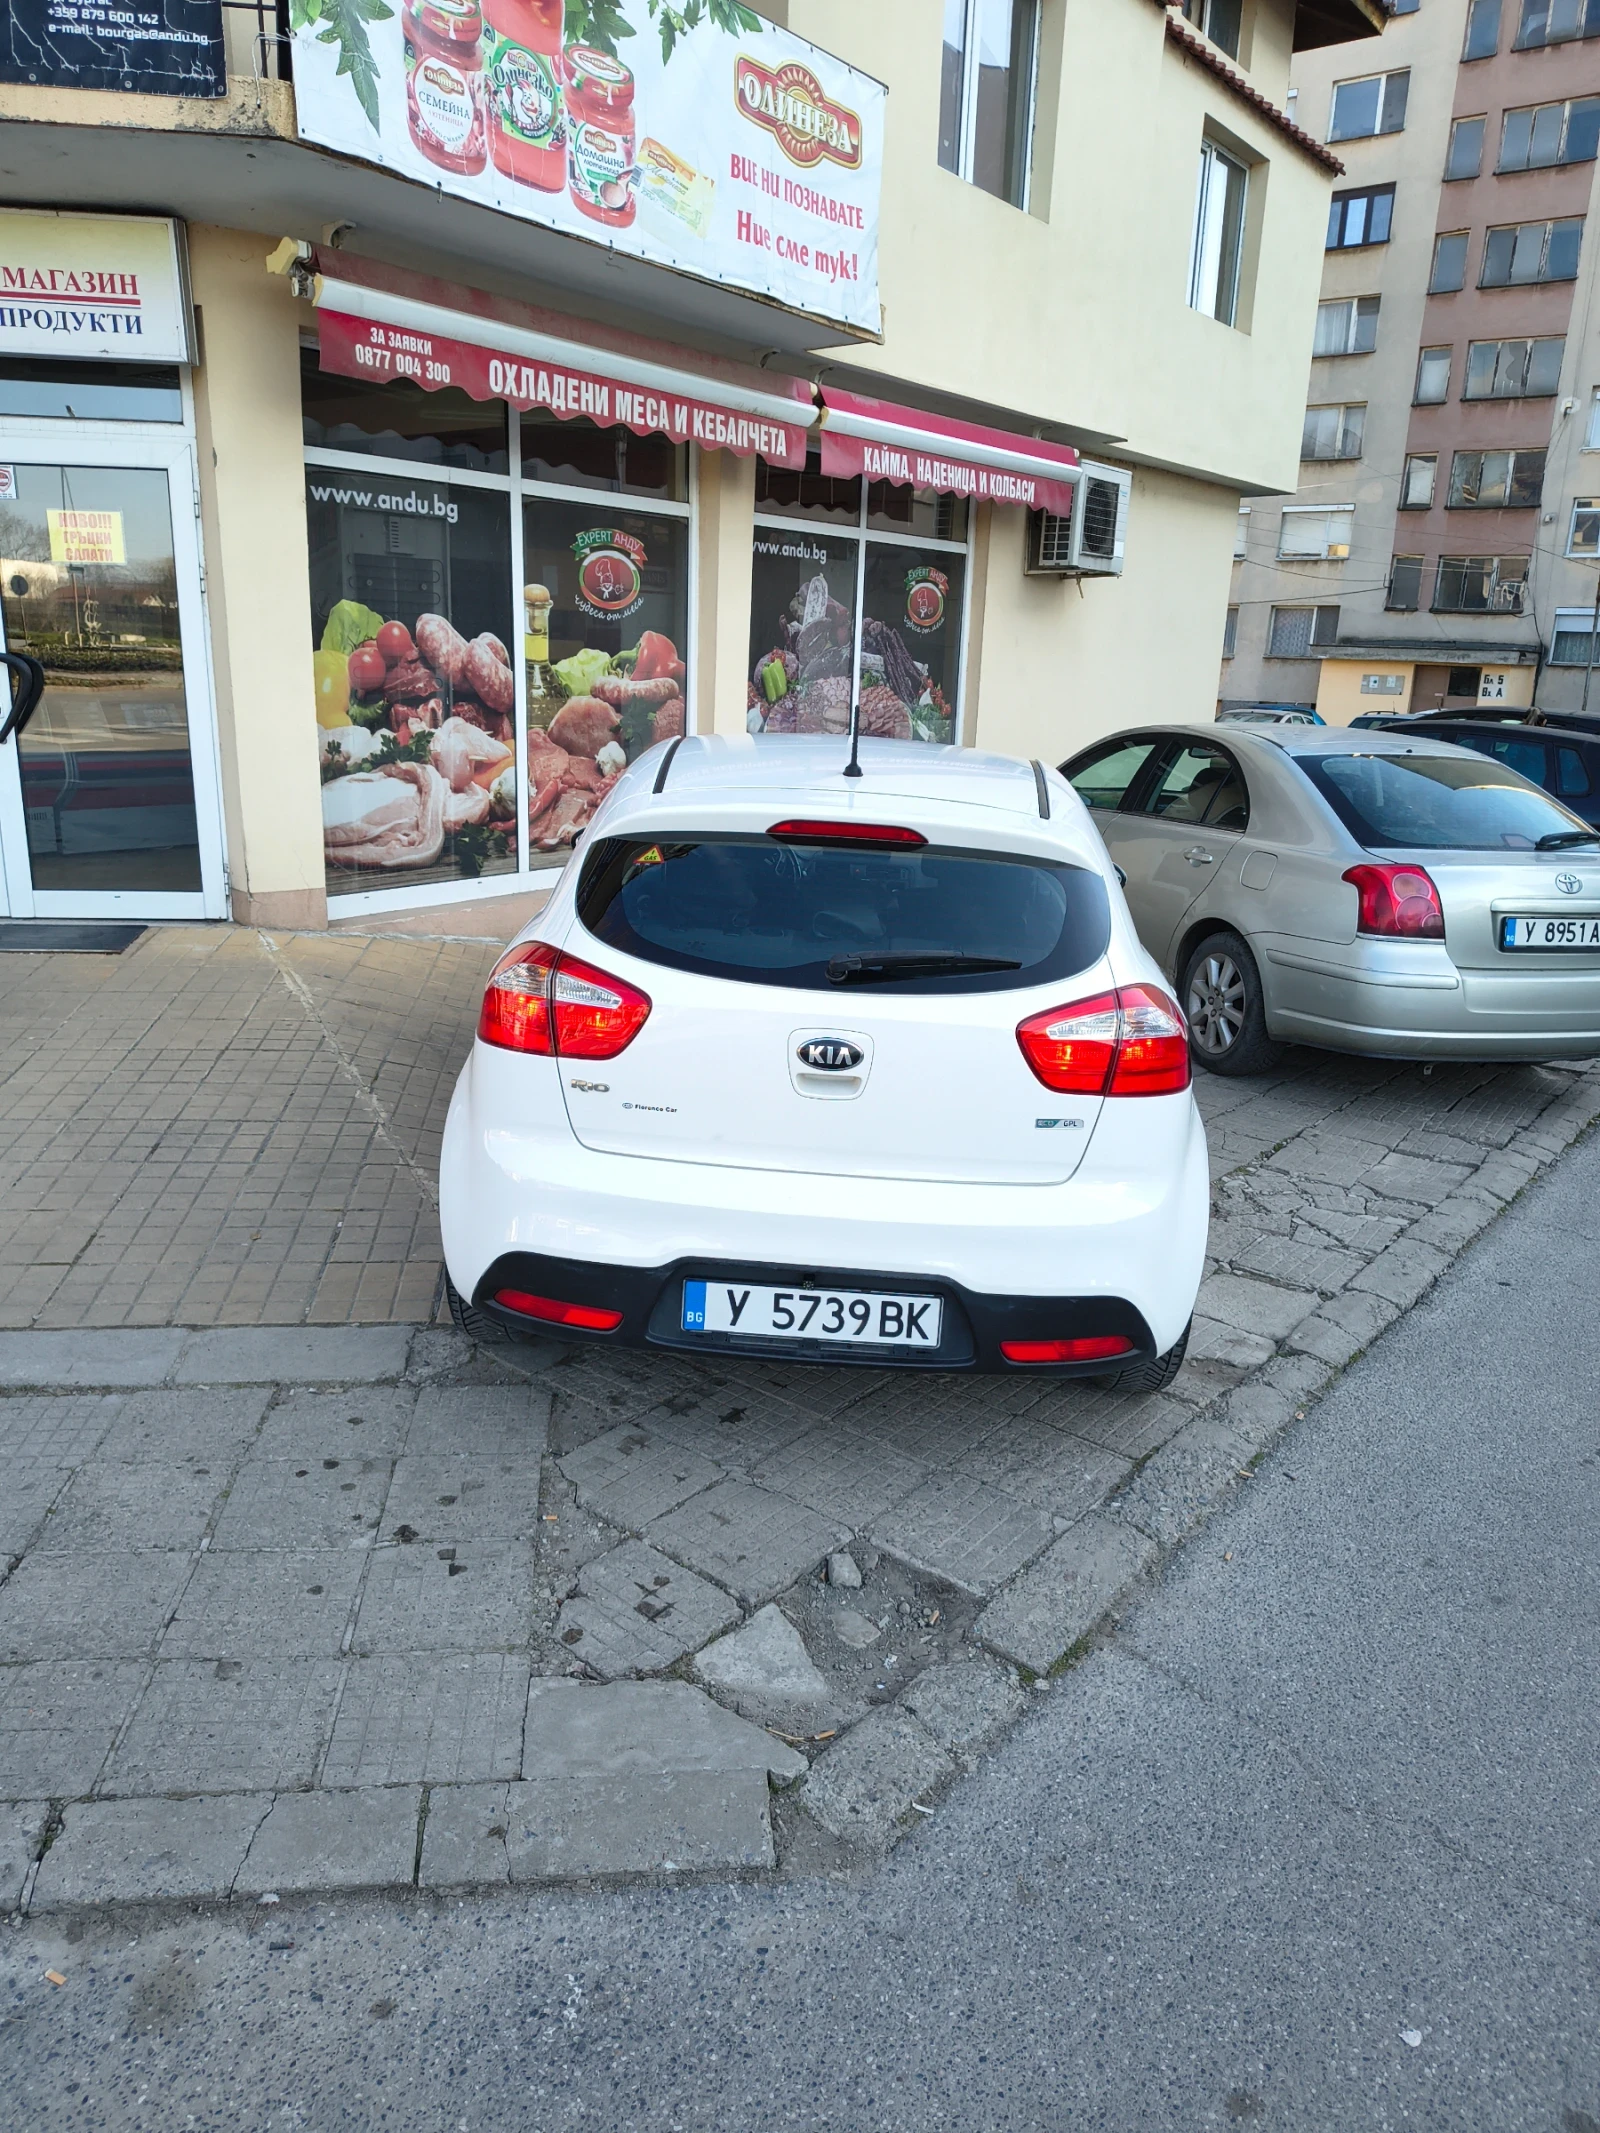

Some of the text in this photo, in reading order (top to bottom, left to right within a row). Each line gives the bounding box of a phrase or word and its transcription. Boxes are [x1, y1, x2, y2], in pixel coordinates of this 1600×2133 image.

[48, 7, 159, 25] +359 879 600 142
[48, 23, 208, 45] e-mail: bourgas@andu.bg
[418, 90, 471, 120] СЕМЕЙНА
[576, 143, 625, 170] Домашна
[730, 153, 864, 230] ВИЕ НИ ПОЗНАВАТЕ
[737, 209, 858, 284] Ние сме тук!
[1, 266, 139, 296] МАГАЗИН
[0, 307, 143, 335] ПРОДУКТИ
[370, 327, 433, 356] ЗА ЗАЯВКИ
[355, 343, 451, 384] 0877 004 300
[488, 359, 788, 457] ОХЛАДЕНИ МЕСА И КЕБАПЧЕТА
[863, 445, 1036, 503] КАЙМА, НАДЕНИЦА И КОЛБАСИ
[310, 485, 459, 523] www.andu.bg
[58, 512, 113, 529] НОВО!!!
[63, 530, 112, 547] ГРЪЦКИ
[577, 530, 641, 551] EXPERT АНДУ
[65, 547, 113, 562] САЛАТИ
[908, 568, 930, 580] EXPERT
[575, 594, 645, 621] чудеса от меса
[1495, 687, 1503, 698] А
[1525, 921, 1537, 943] Y
[808, 1044, 853, 1066] KIA
[634, 1103, 664, 1112] Florence
[686, 1311, 703, 1323] BG
[726, 1288, 751, 1327] Y
